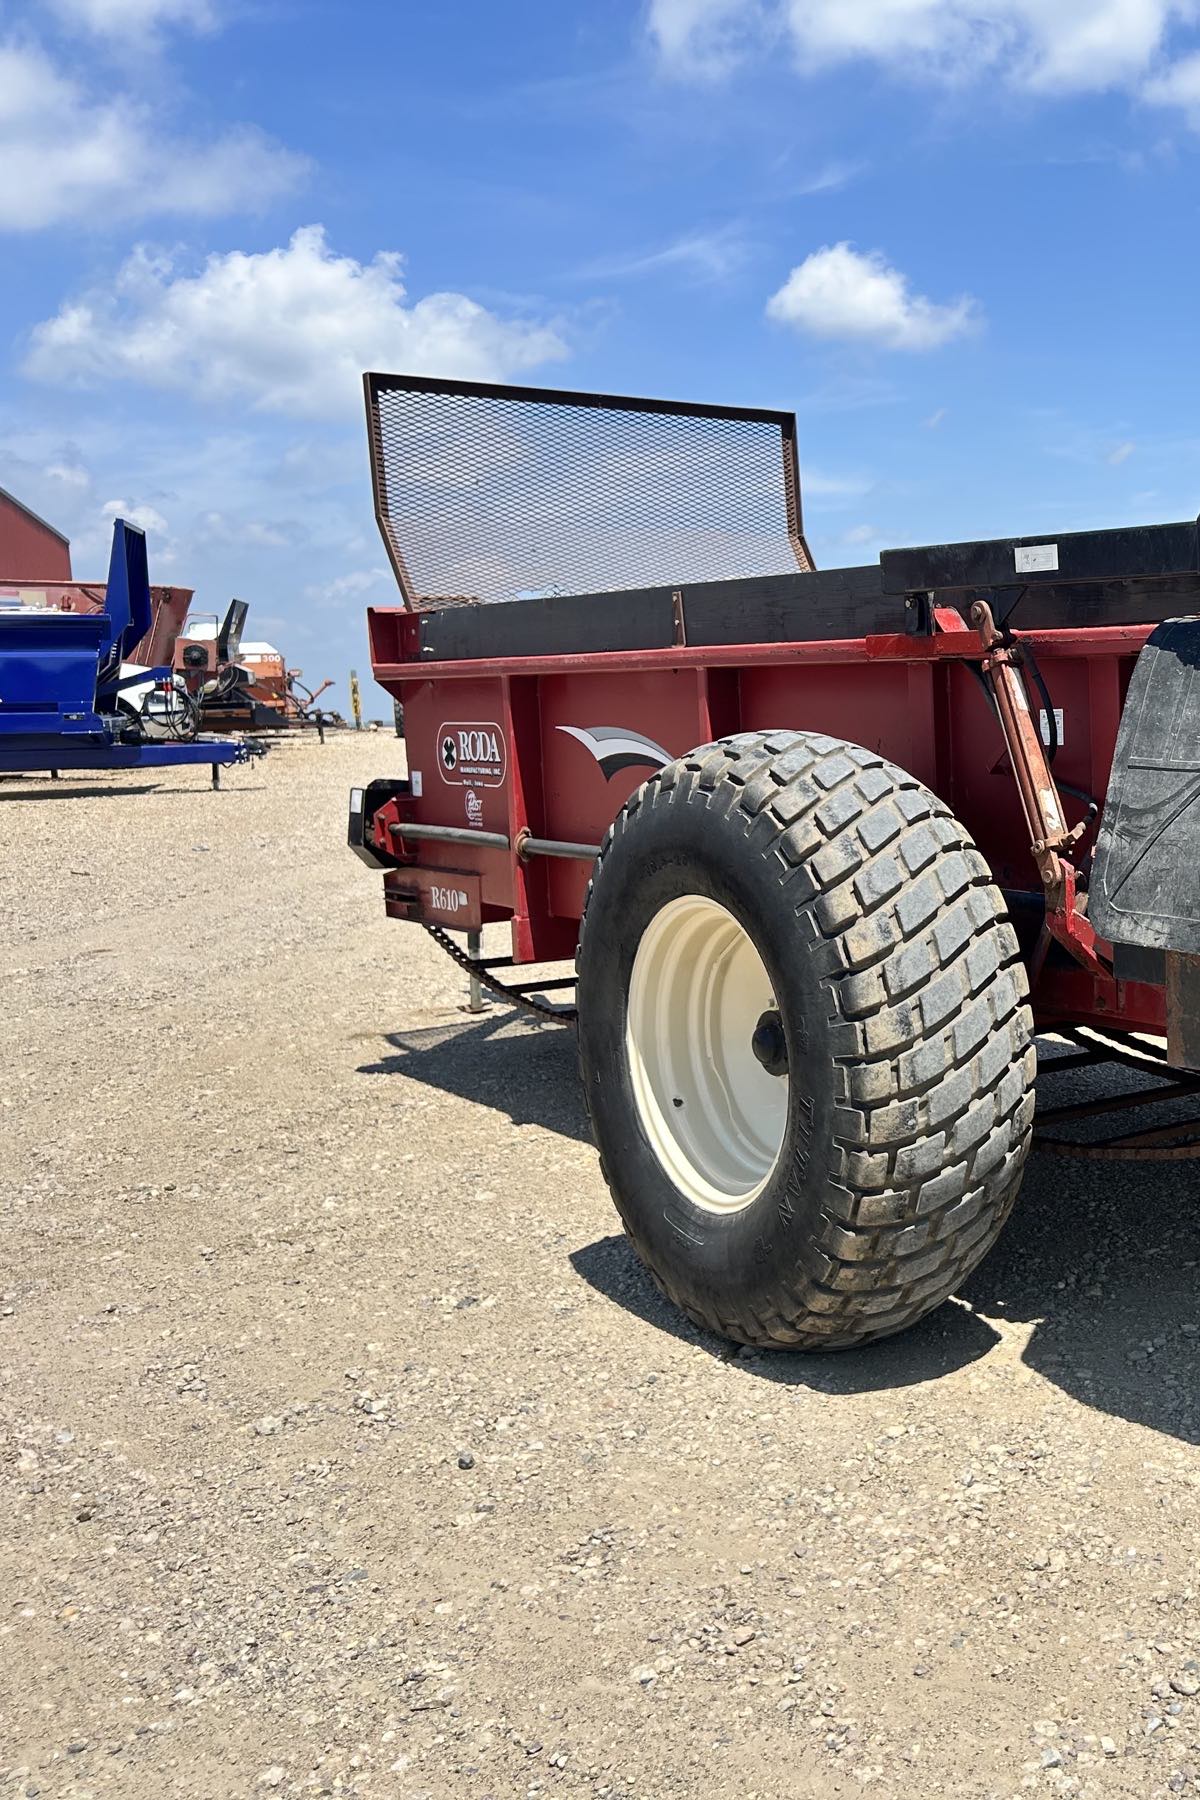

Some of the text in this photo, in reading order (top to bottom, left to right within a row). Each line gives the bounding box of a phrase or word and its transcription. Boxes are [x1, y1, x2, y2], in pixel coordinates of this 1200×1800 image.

[262, 654, 281, 663] 300
[457, 730, 502, 762] RODA
[430, 886, 459, 912] R610
